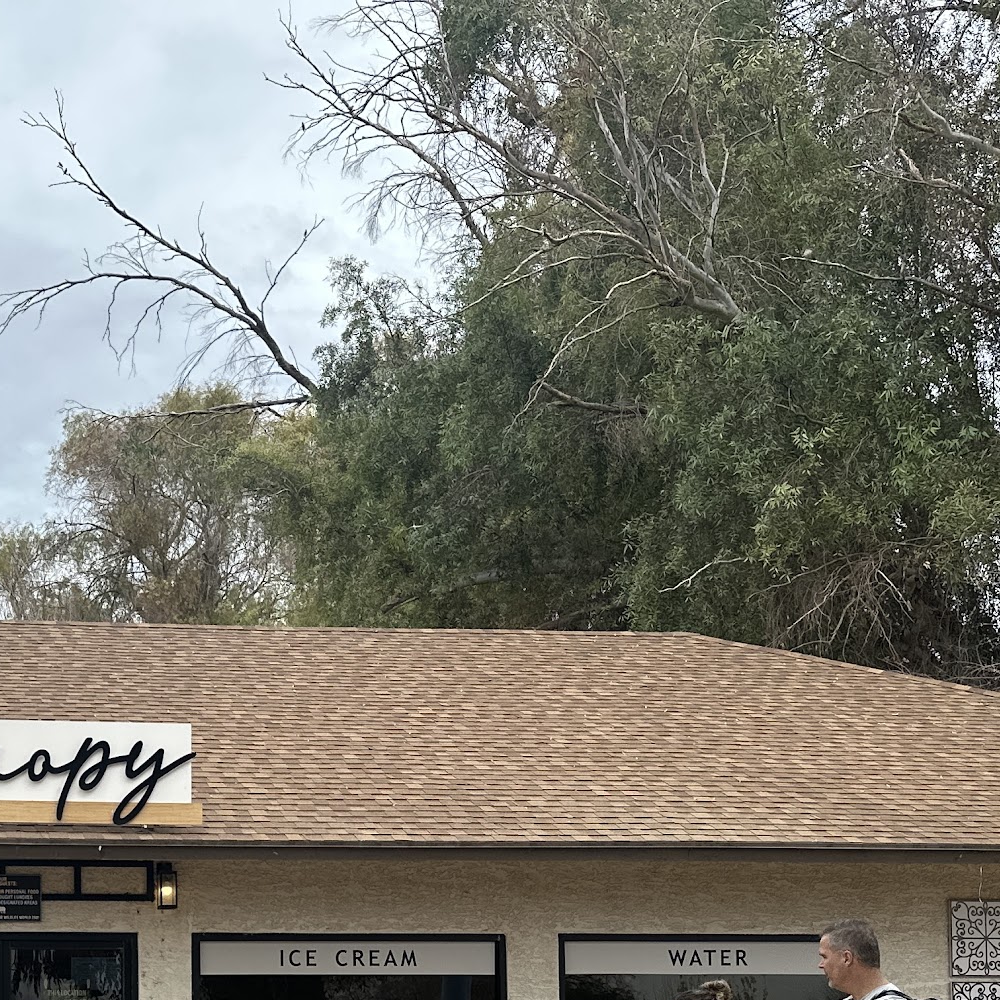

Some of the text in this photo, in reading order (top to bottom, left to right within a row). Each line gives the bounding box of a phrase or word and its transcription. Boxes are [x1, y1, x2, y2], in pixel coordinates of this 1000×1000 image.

[280, 949, 418, 967] ICE CREAM
[668, 949, 748, 967] WATER
